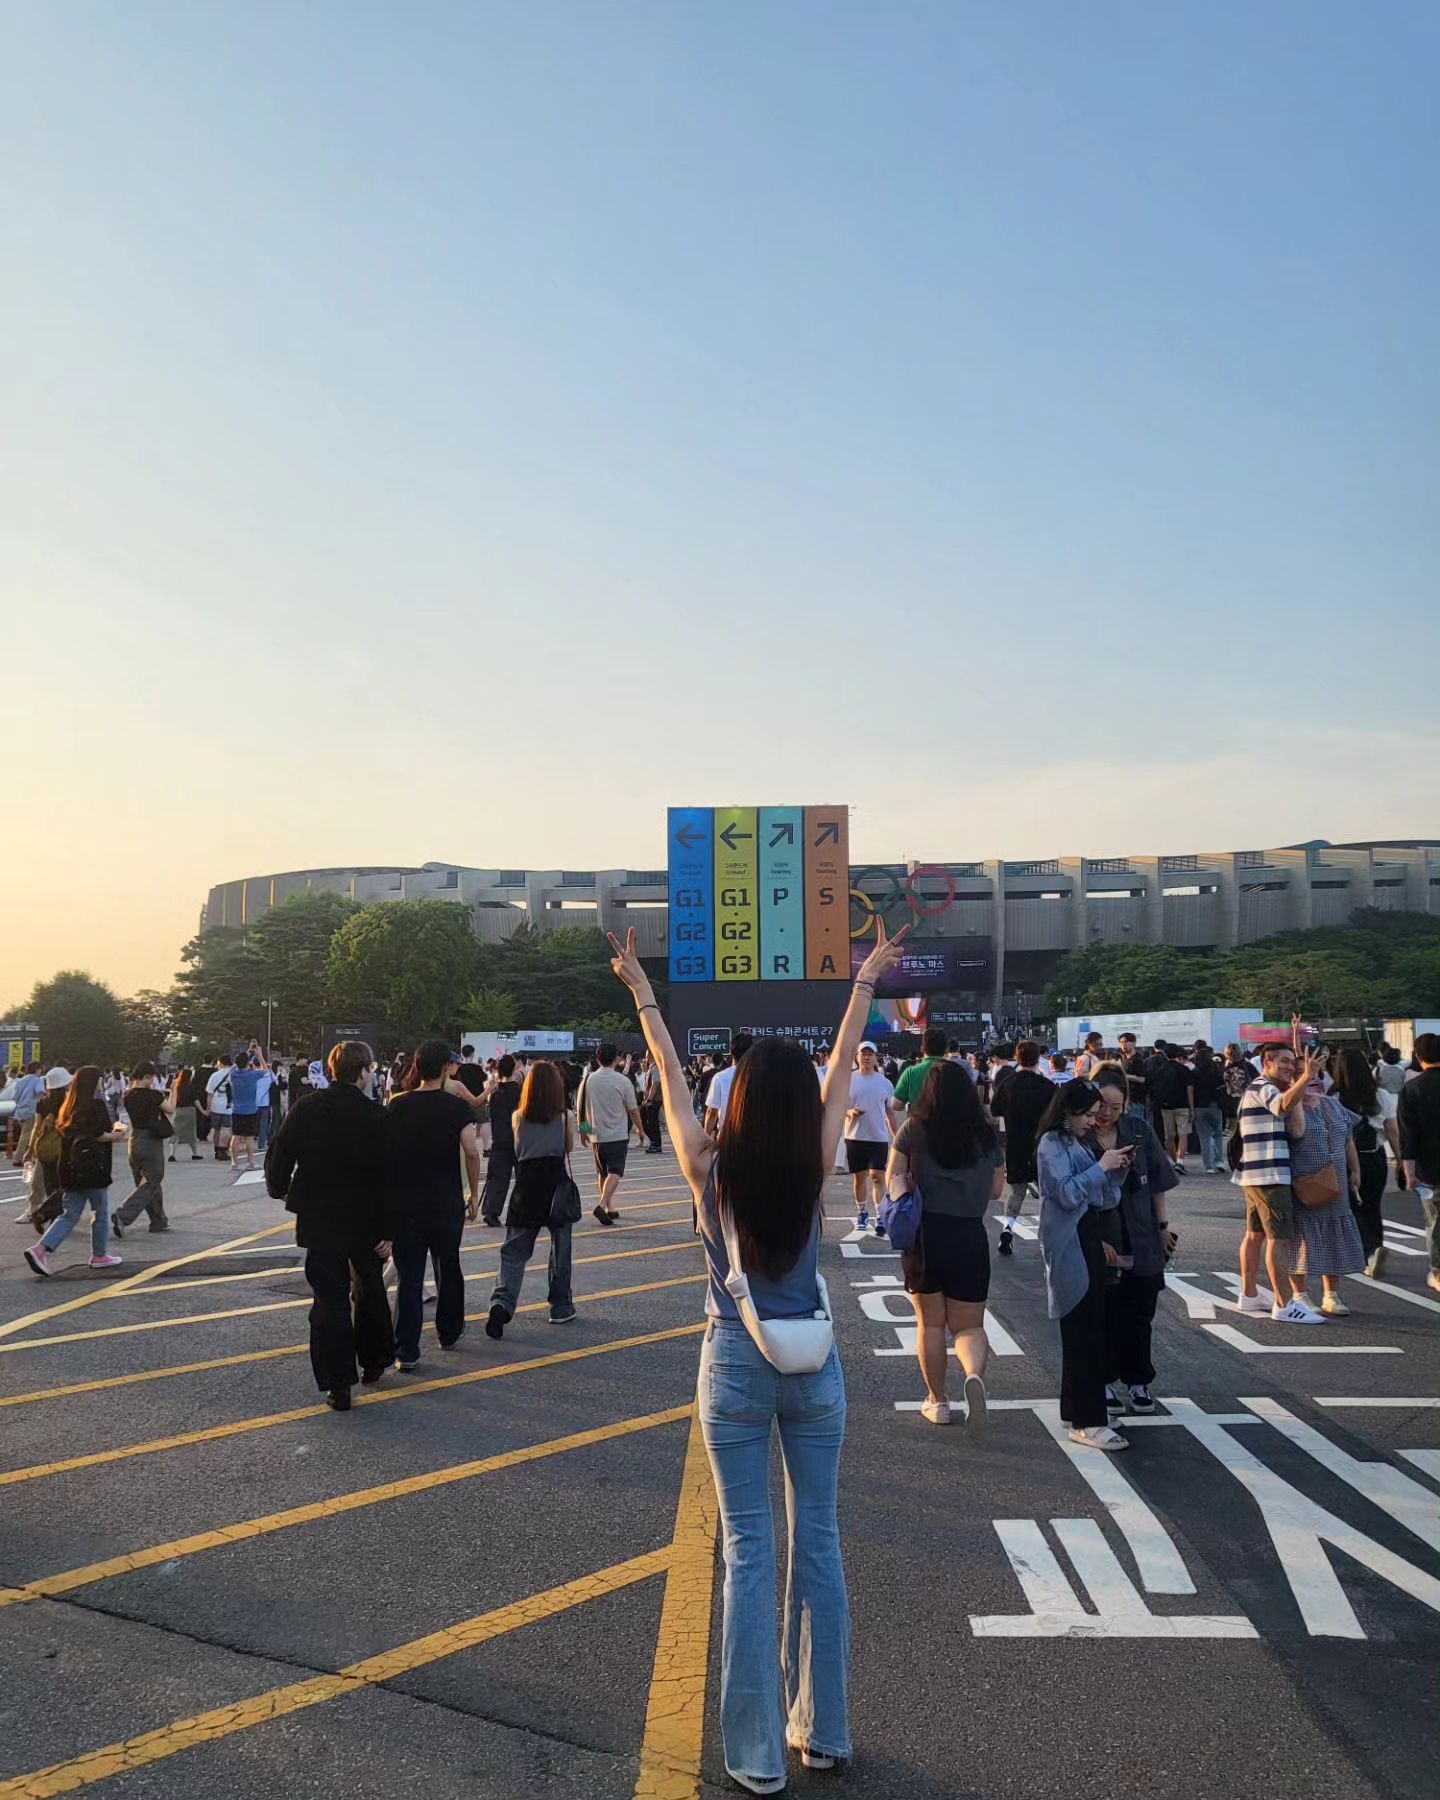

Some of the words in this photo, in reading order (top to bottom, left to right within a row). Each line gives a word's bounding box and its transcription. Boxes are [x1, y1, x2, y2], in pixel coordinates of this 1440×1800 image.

[675, 889, 705, 908] G1
[721, 888, 751, 907] G1
[773, 887, 789, 906] P
[819, 887, 834, 906] S
[676, 922, 706, 942] G2
[721, 922, 752, 941] G2
[676, 955, 706, 976] G3
[721, 955, 752, 974] G3
[773, 955, 790, 974] R
[819, 954, 836, 974] A
[928, 960, 945, 969] 마스
[693, 1033, 720, 1042] Super
[740, 1026, 776, 1036] 대카드
[776, 1026, 819, 1037] 슈퍼콘서트
[820, 1026, 833, 1036] 27
[693, 1042, 727, 1051] Concert
